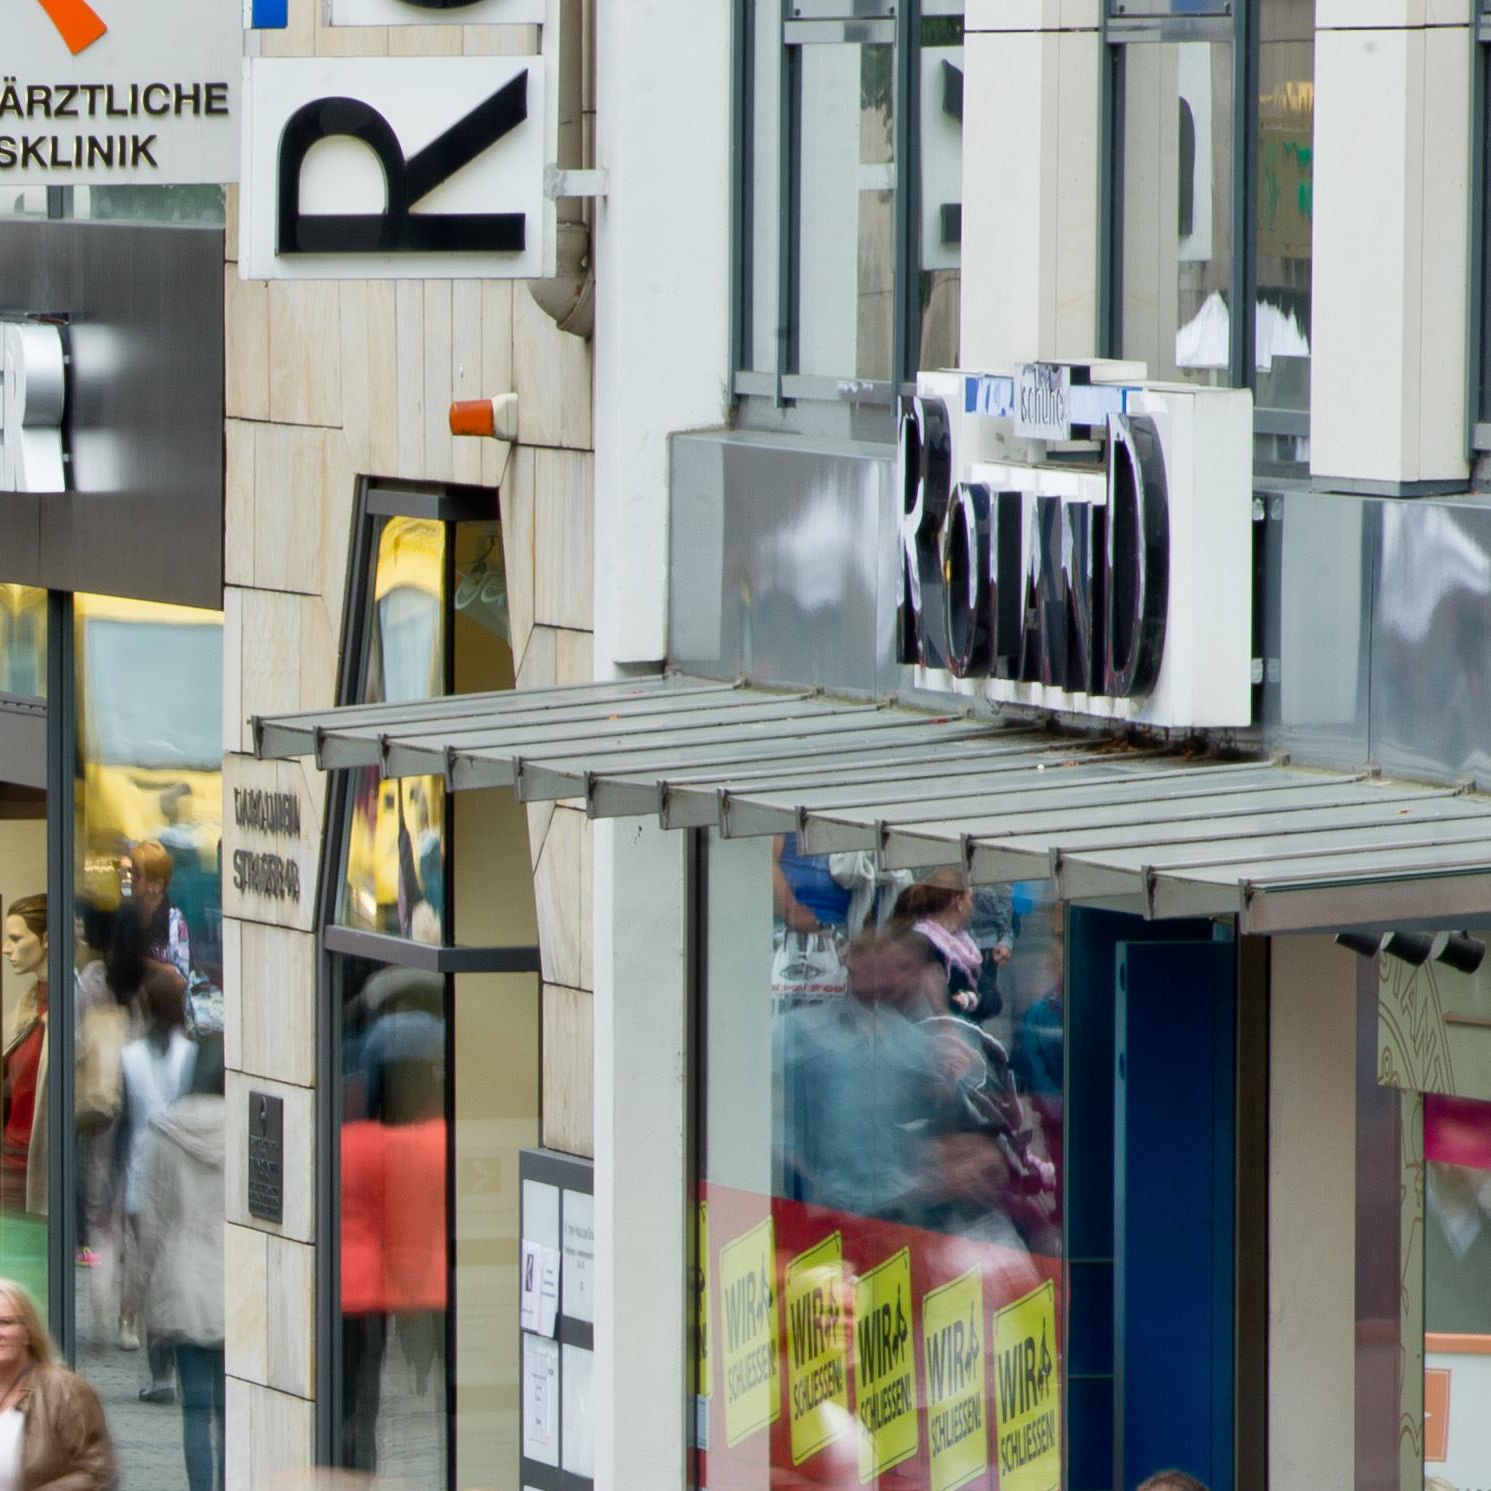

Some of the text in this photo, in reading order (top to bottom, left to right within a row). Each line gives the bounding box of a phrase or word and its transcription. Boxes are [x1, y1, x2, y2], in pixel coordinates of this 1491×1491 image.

[724, 1270, 757, 1354] WIR
[790, 1287, 826, 1370] WIR
[857, 1302, 893, 1388] WIR
[793, 1355, 843, 1420] SCHLIESSEN!
[926, 1319, 965, 1406] WIR
[998, 1336, 1039, 1425] WIR
[860, 1372, 913, 1437] SCHLIESSEN!
[931, 1390, 982, 1458] SCHLIESSEN!
[1001, 1408, 1056, 1477] SCHLIESSEN!
